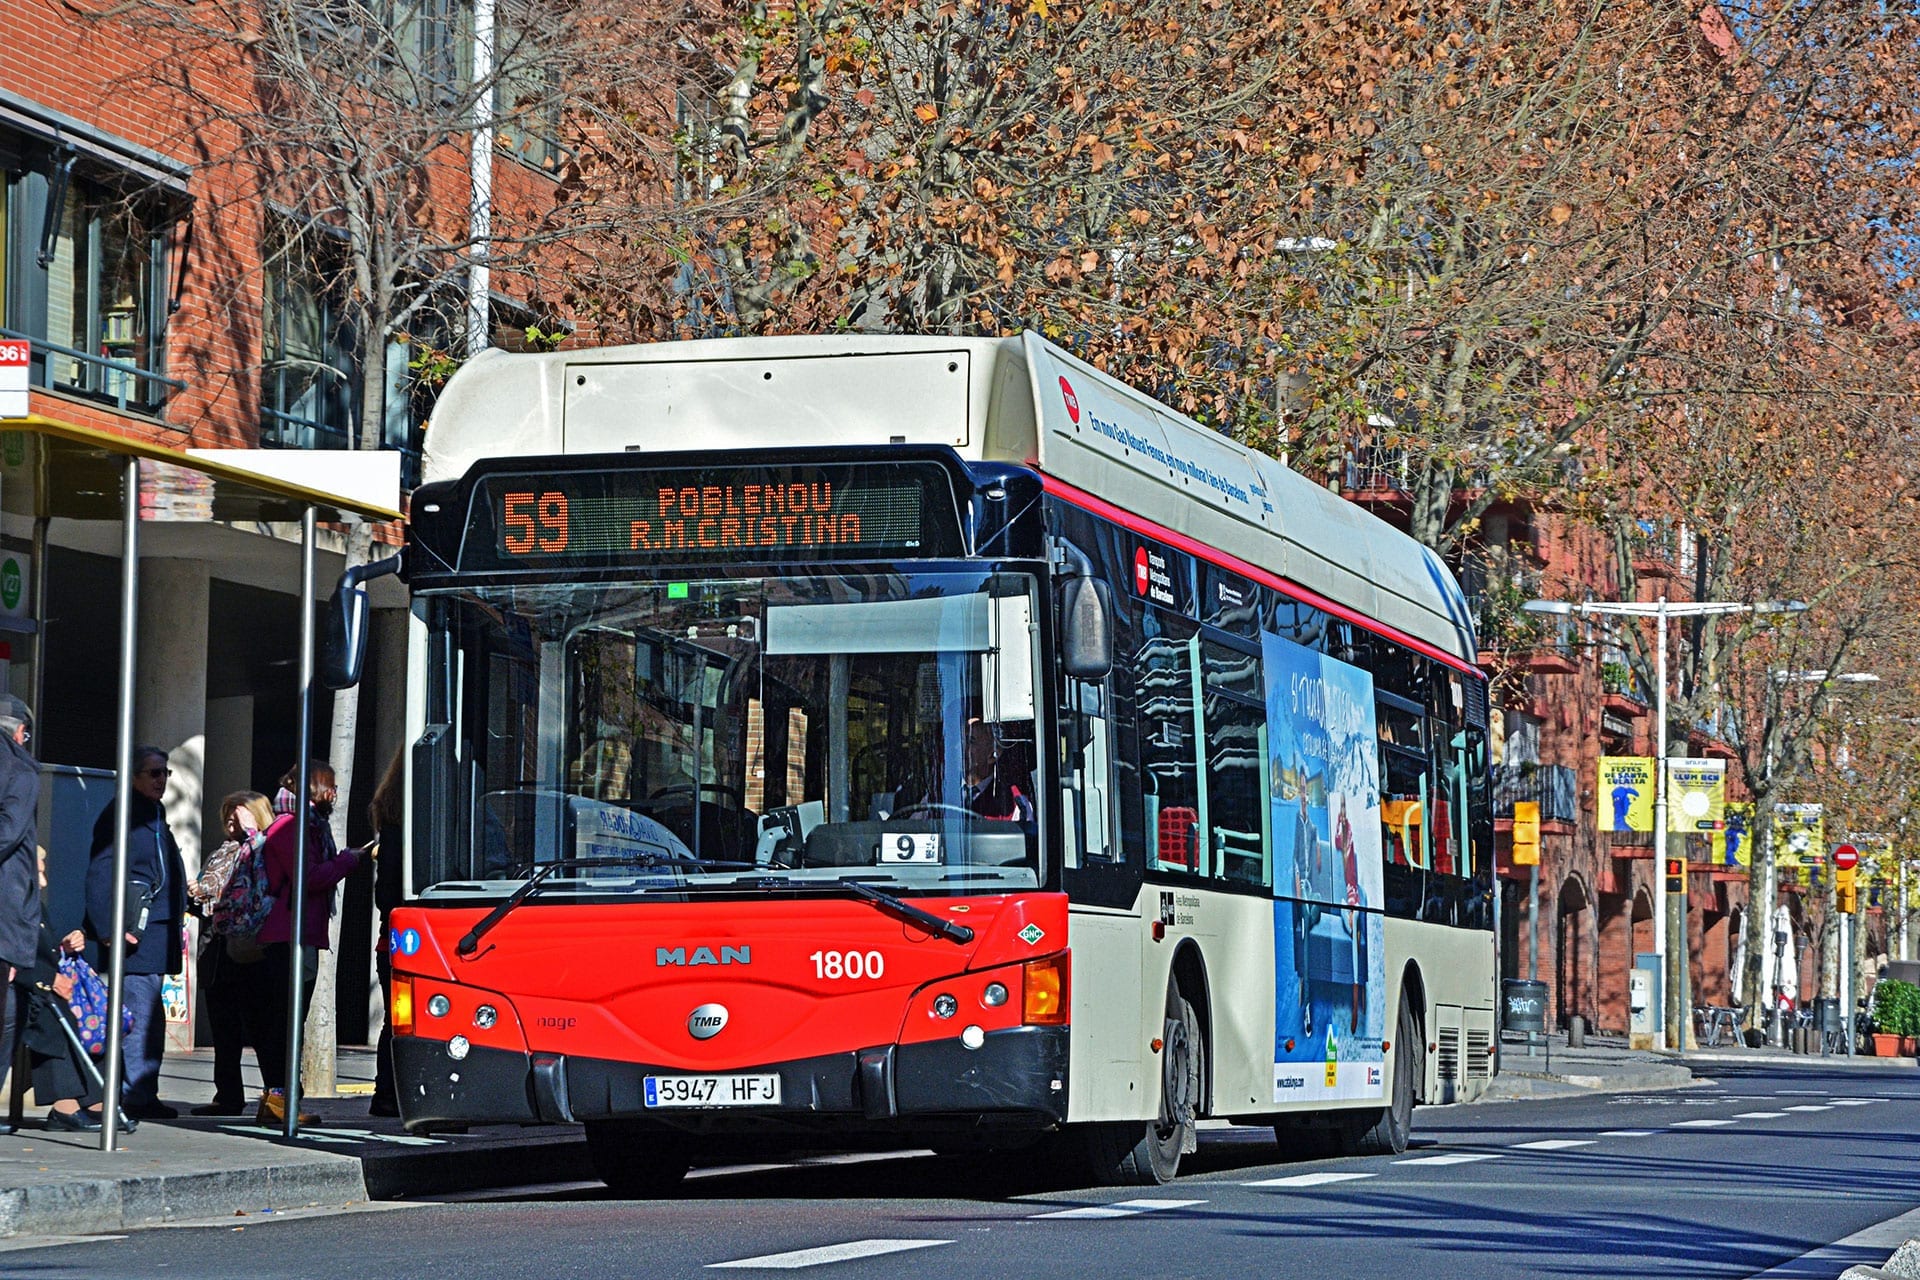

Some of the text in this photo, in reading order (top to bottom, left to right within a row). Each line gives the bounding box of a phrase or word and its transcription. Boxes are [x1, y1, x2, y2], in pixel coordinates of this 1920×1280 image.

[1064, 391, 1078, 409] TMB
[1113, 422, 1127, 445] Gas
[1124, 428, 1147, 454] Natural
[659, 482, 831, 517] POBLENOU
[505, 492, 568, 553] 59
[630, 513, 860, 550] R.M.CRISTINA
[1137, 563, 1147, 580] TMB
[1674, 773, 1698, 781] LLUM
[897, 835, 915, 860] 9
[1022, 930, 1040, 939] GNC
[655, 946, 750, 966] MAN
[809, 950, 885, 979] 1800
[537, 1016, 577, 1030] noge
[694, 1016, 722, 1027] TMB
[649, 1078, 775, 1102] E 5947 HFJ
